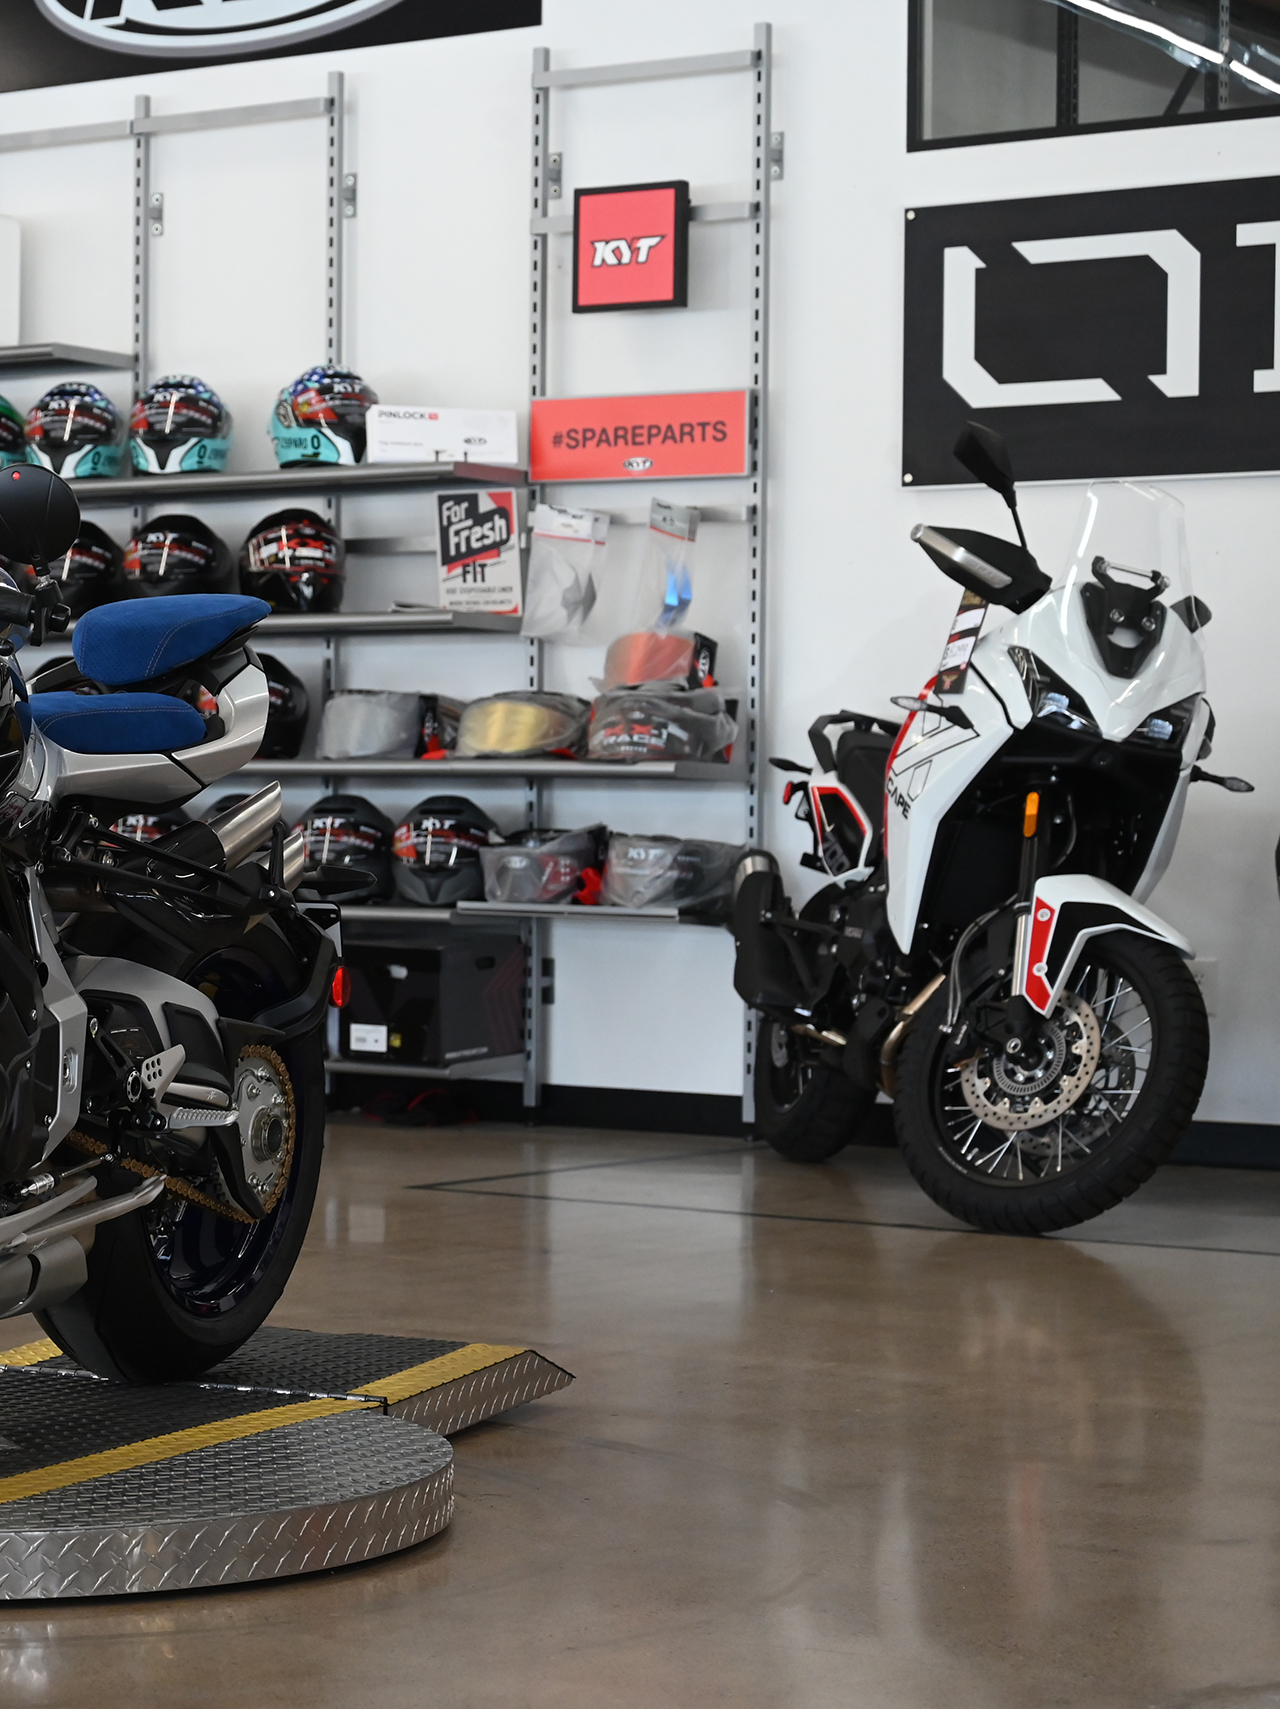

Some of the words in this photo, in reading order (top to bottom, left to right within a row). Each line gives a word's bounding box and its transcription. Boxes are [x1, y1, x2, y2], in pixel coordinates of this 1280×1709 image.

[591, 234, 666, 267] KYT
[378, 410, 427, 420] PINLOCK
[552, 420, 728, 450] #SPAREPARTS
[441, 499, 469, 527] For
[448, 513, 508, 557] Fresh
[462, 559, 488, 583] FIT
[886, 777, 911, 820] CAPE
